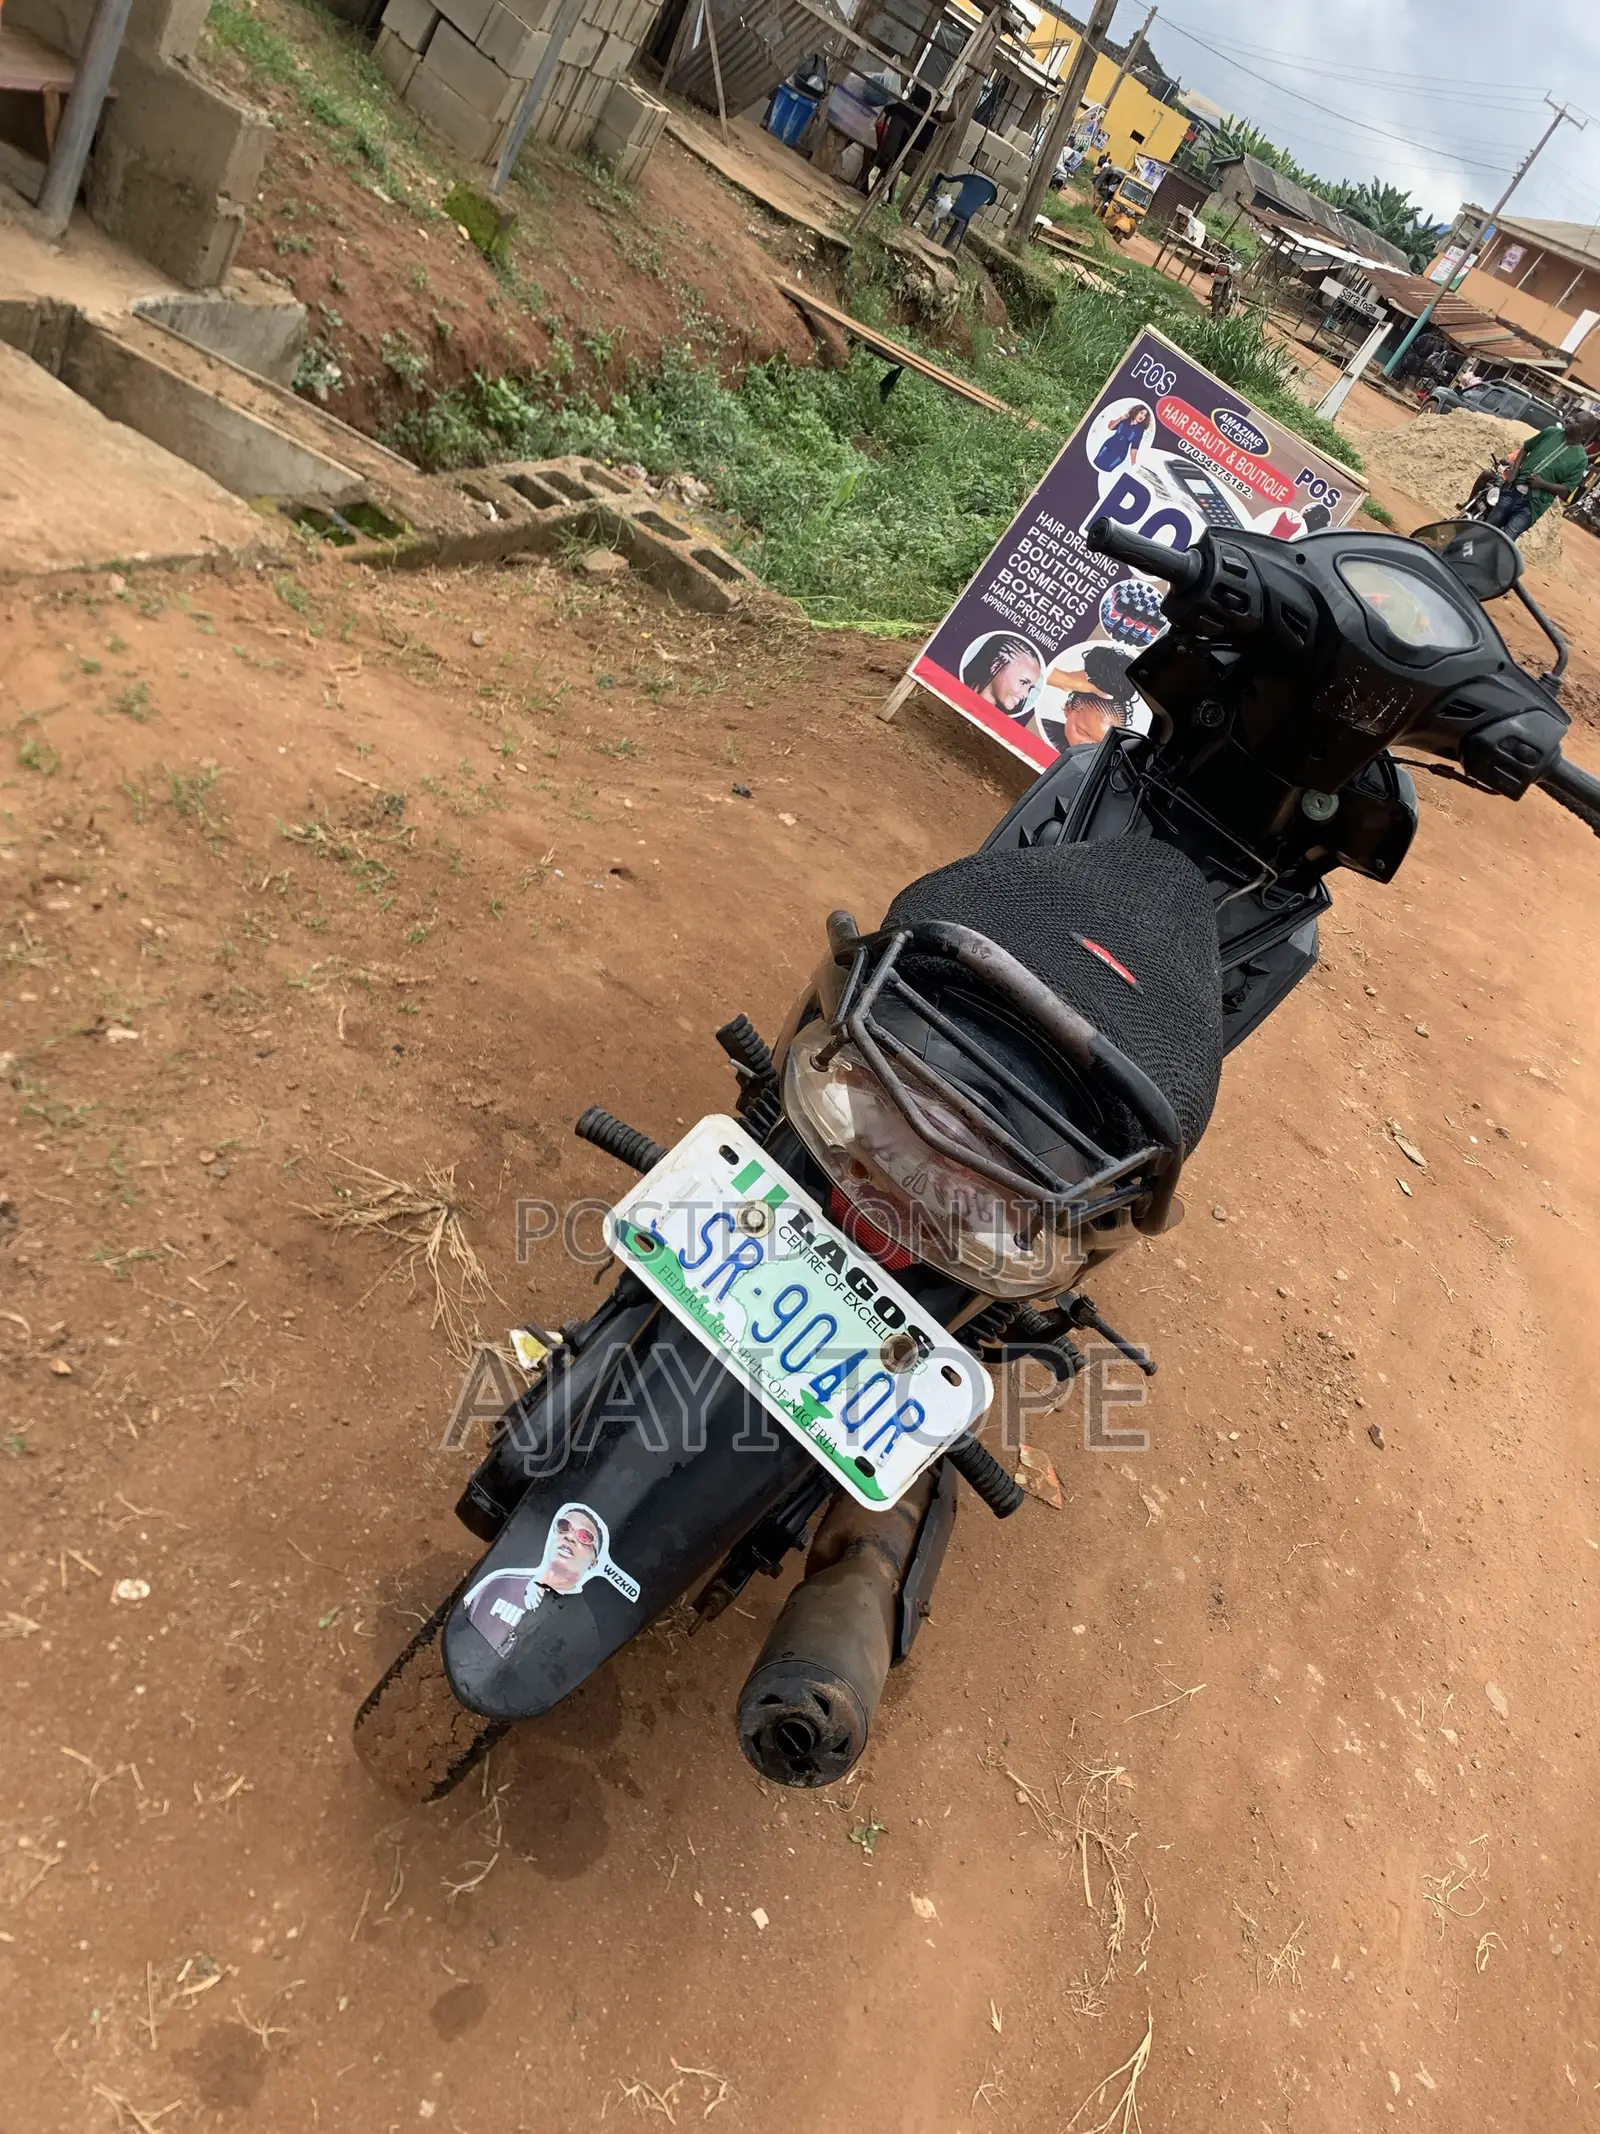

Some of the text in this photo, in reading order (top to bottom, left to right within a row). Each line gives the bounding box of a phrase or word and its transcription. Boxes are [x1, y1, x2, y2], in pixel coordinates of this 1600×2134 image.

[1340, 288, 1360, 305] Sara
[1130, 352, 1177, 397] POS
[1161, 402, 1290, 502] HAIR BEAUTY & BOUTIQUE
[1218, 412, 1264, 447] AMAZING
[1219, 424, 1257, 452] GLORY
[1294, 466, 1342, 509] POS
[1035, 510, 1066, 539] HAIR
[1008, 553, 1089, 617] COSMETICS
[1017, 537, 1101, 603] BOUTIQUE
[1027, 525, 1110, 590] PERFUMES
[980, 592, 1059, 652] APPRENTICE TRAINING
[988, 580, 1069, 641] HAIR PRODUCT
[997, 567, 1077, 630] BOXERS
[778, 1224, 827, 1275] CENTRE
[824, 1272, 847, 1293] OF
[787, 1208, 936, 1360] LAGOS
[657, 1264, 839, 1456] FEDERAL REPUBLIC OF NIGERIA
[603, 1563, 639, 1599] WIZKID
